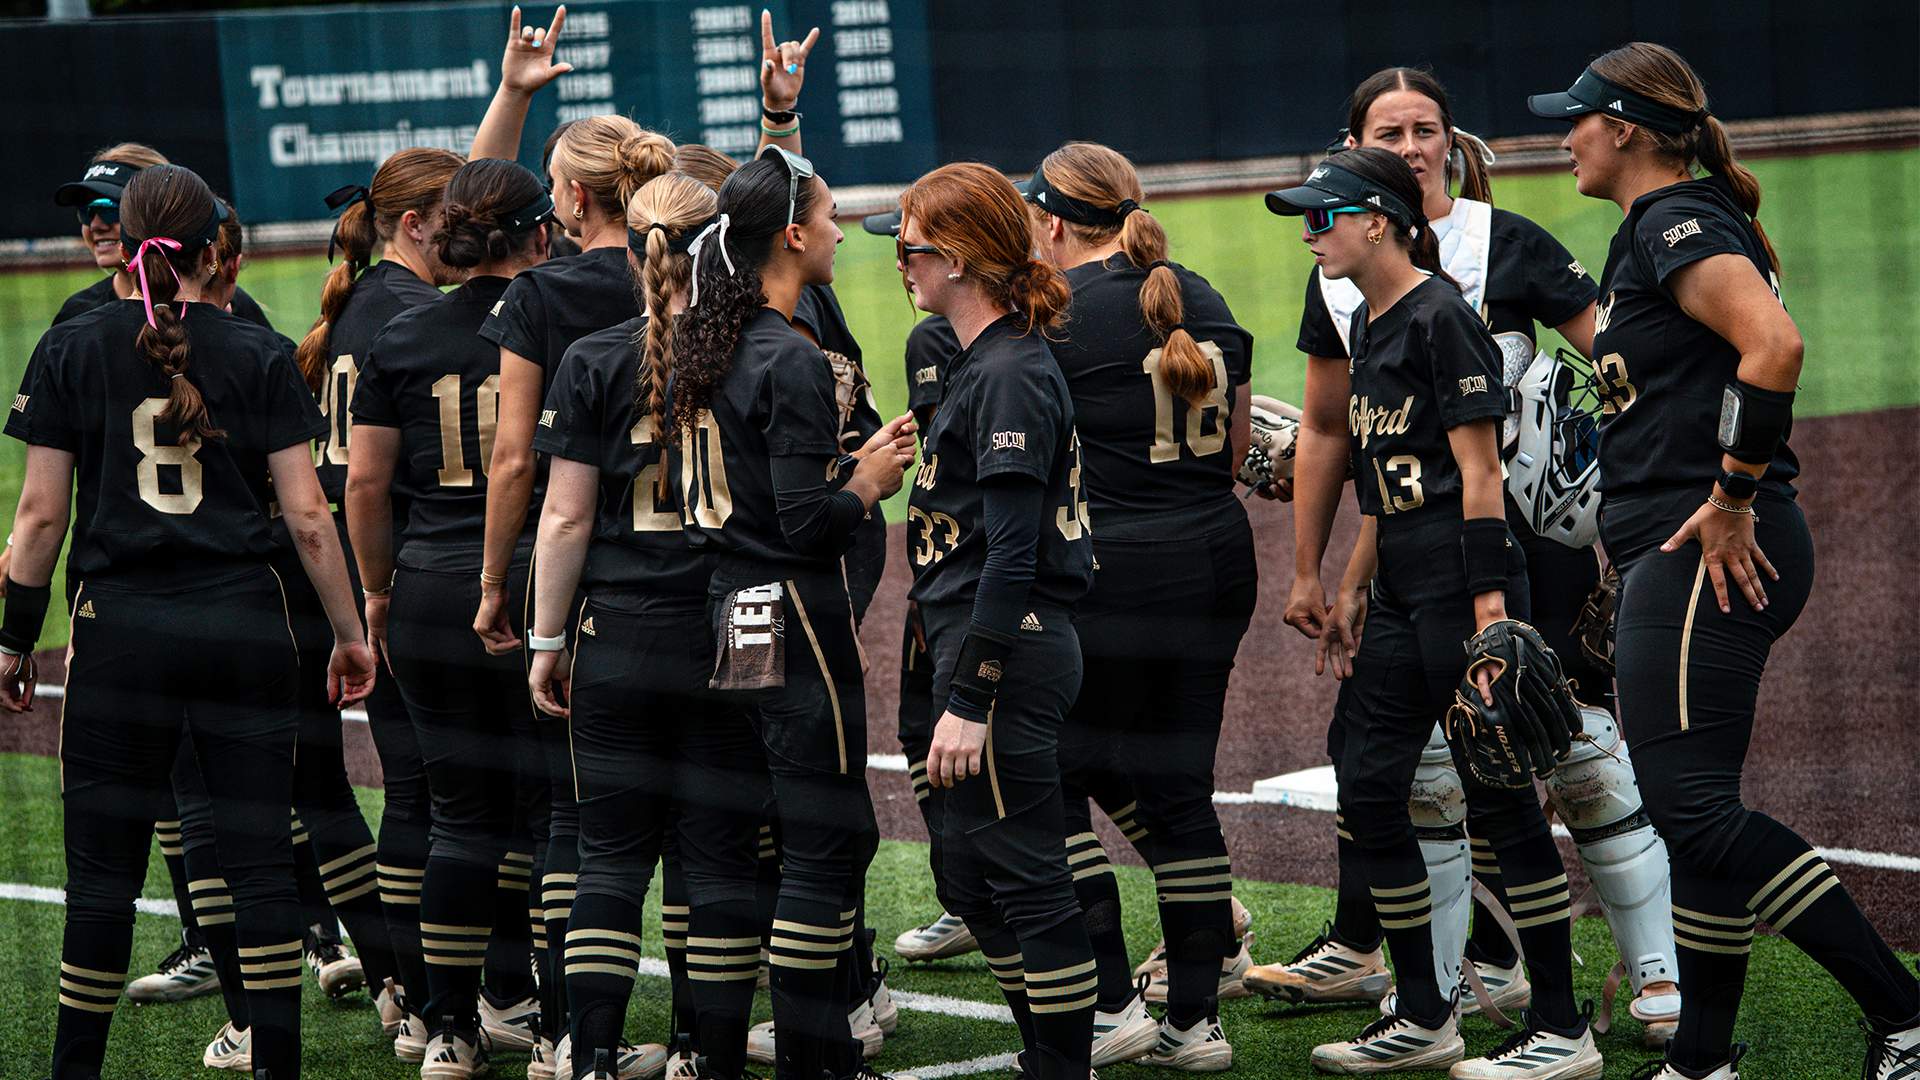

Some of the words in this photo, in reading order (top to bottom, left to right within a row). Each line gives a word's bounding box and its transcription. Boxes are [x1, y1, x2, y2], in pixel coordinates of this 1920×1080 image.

[250, 59, 490, 109] Tournament
[1662, 218, 1702, 248] SOCON
[1142, 340, 1229, 464] 18
[132, 398, 203, 515] 8
[992, 430, 1026, 452] SOCON
[1372, 455, 1425, 515] 13
[908, 505, 960, 566] 33
[1494, 725, 1522, 774] EASTON
